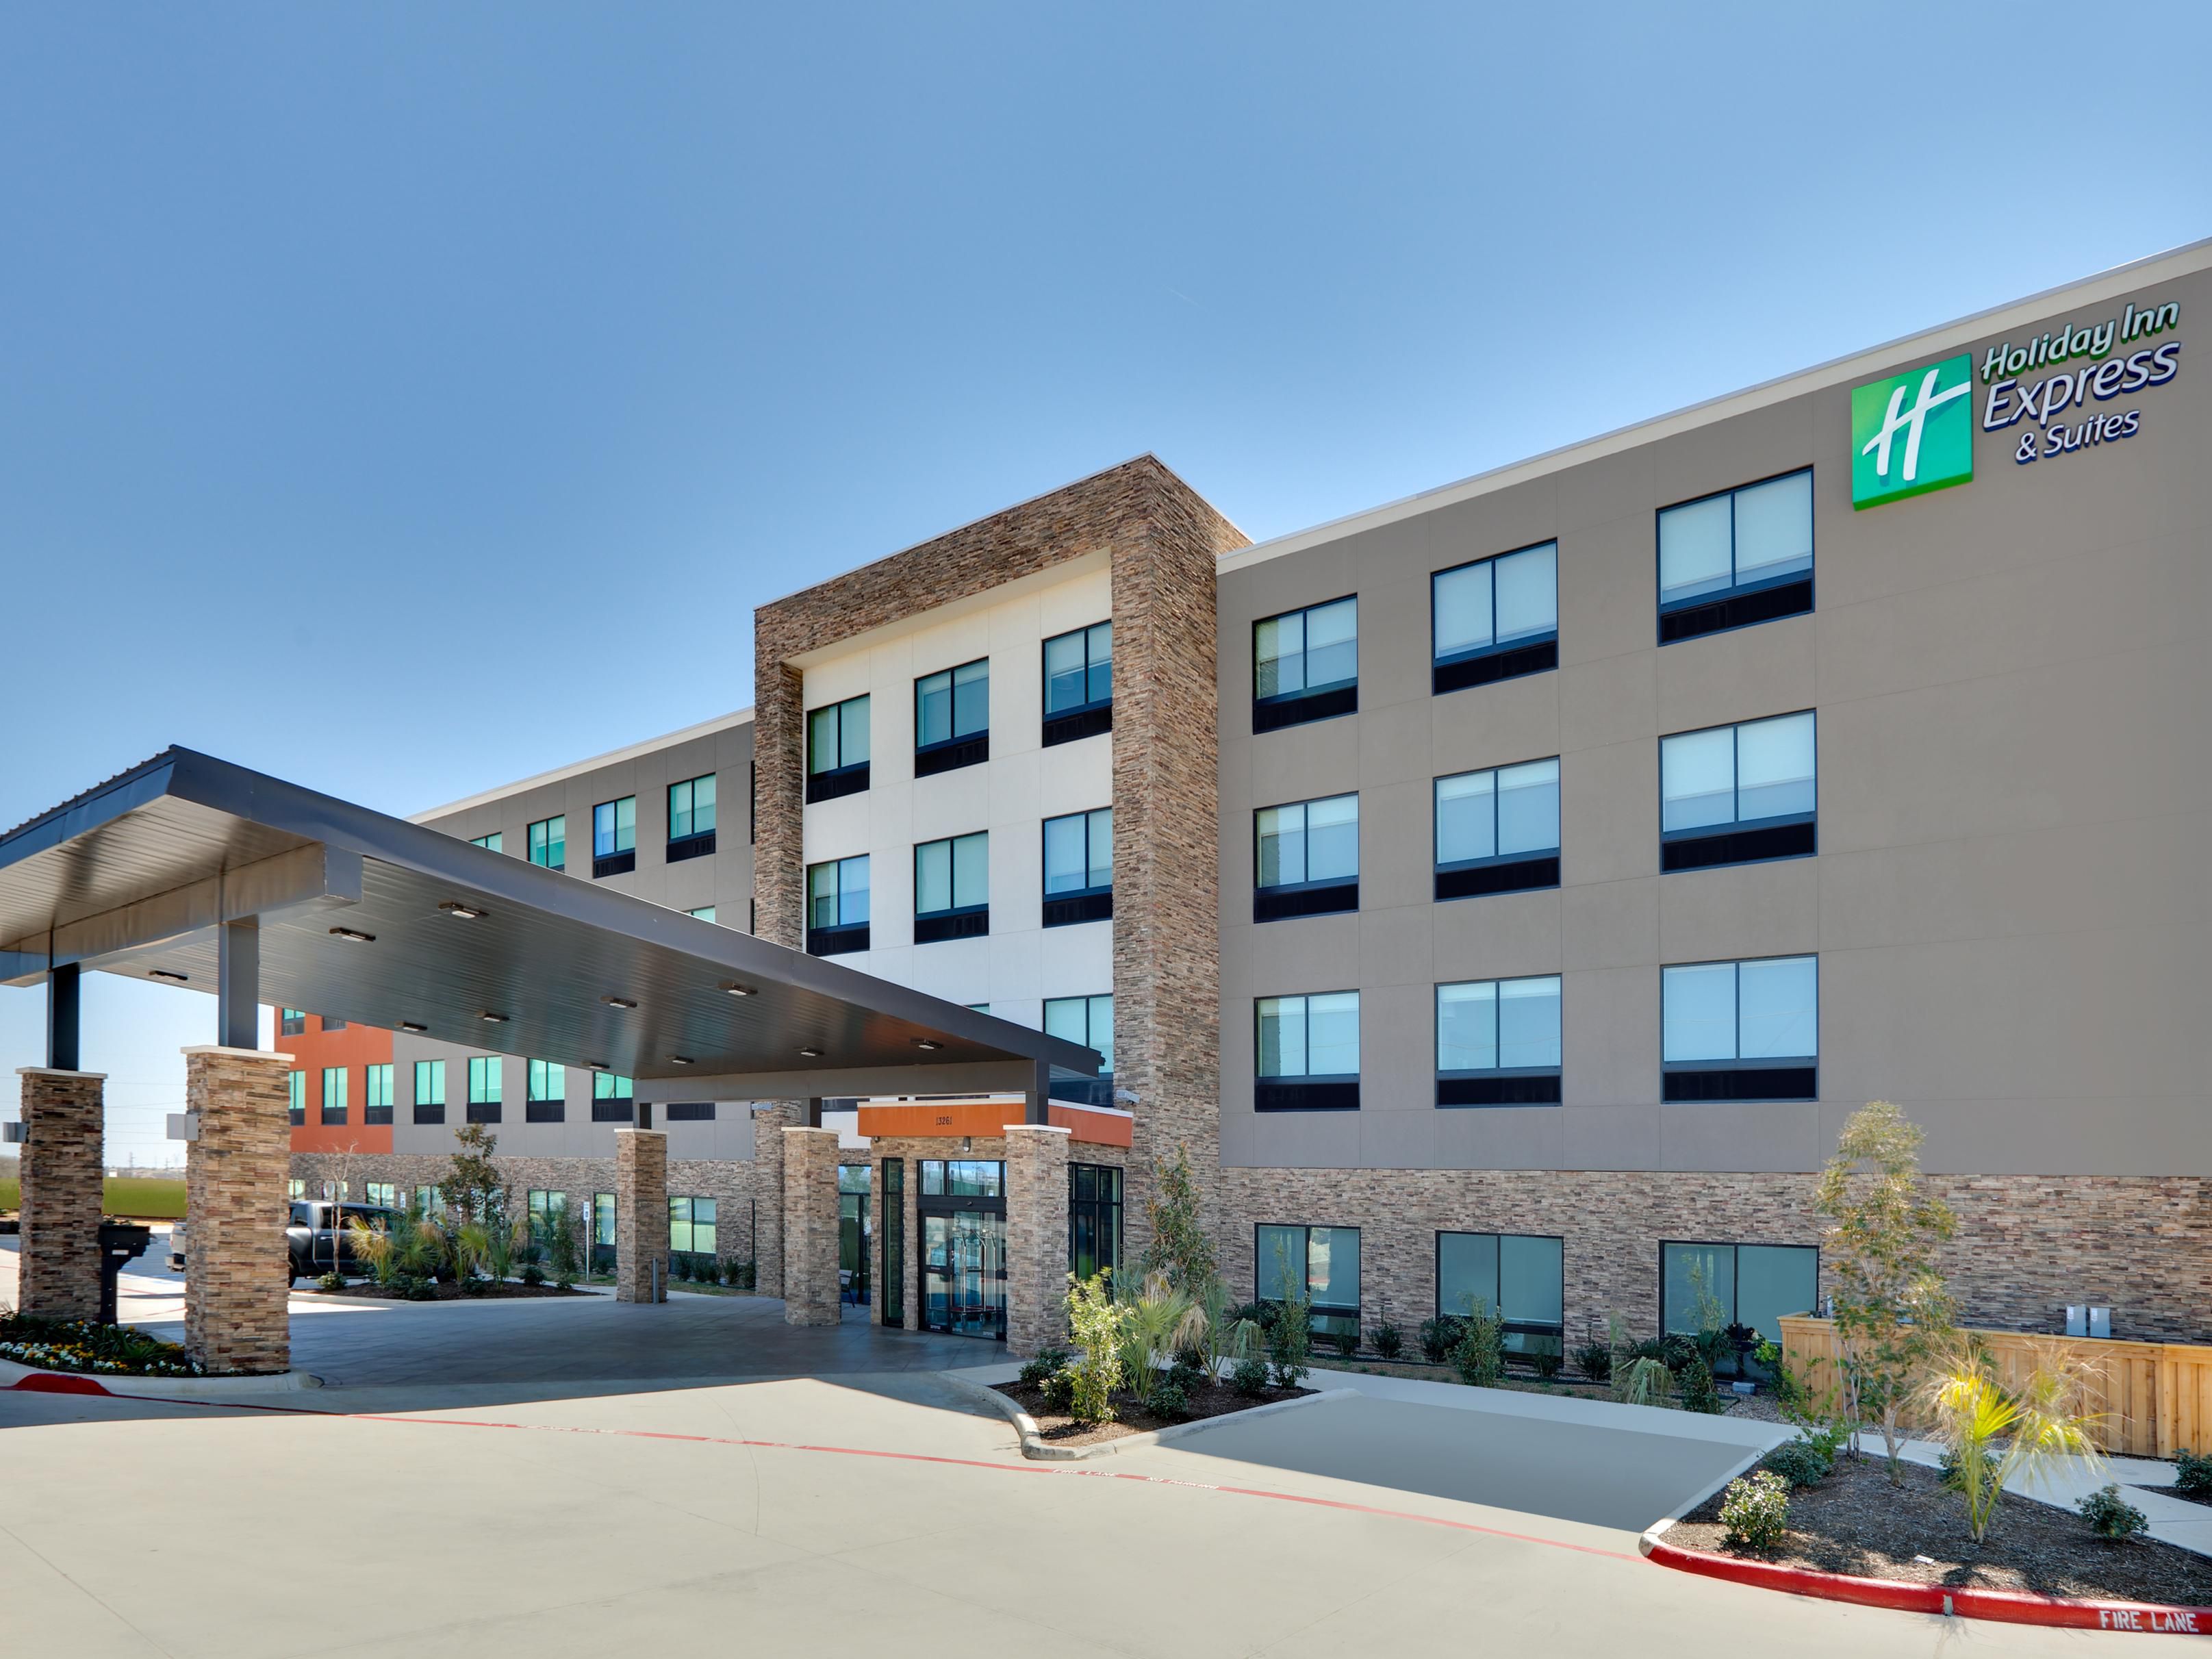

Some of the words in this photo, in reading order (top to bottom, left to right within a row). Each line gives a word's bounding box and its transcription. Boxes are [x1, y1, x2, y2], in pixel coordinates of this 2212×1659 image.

[1982, 318, 2115, 383] Holiday
[2121, 301, 2180, 344] Inn
[1983, 342, 2181, 431] Express
[2016, 433, 2037, 464] &
[2044, 411, 2140, 458] Suites
[936, 1116, 952, 1126] 13261
[2100, 1610, 2143, 1630] FIRE
[2151, 1612, 2199, 1632] LANE
